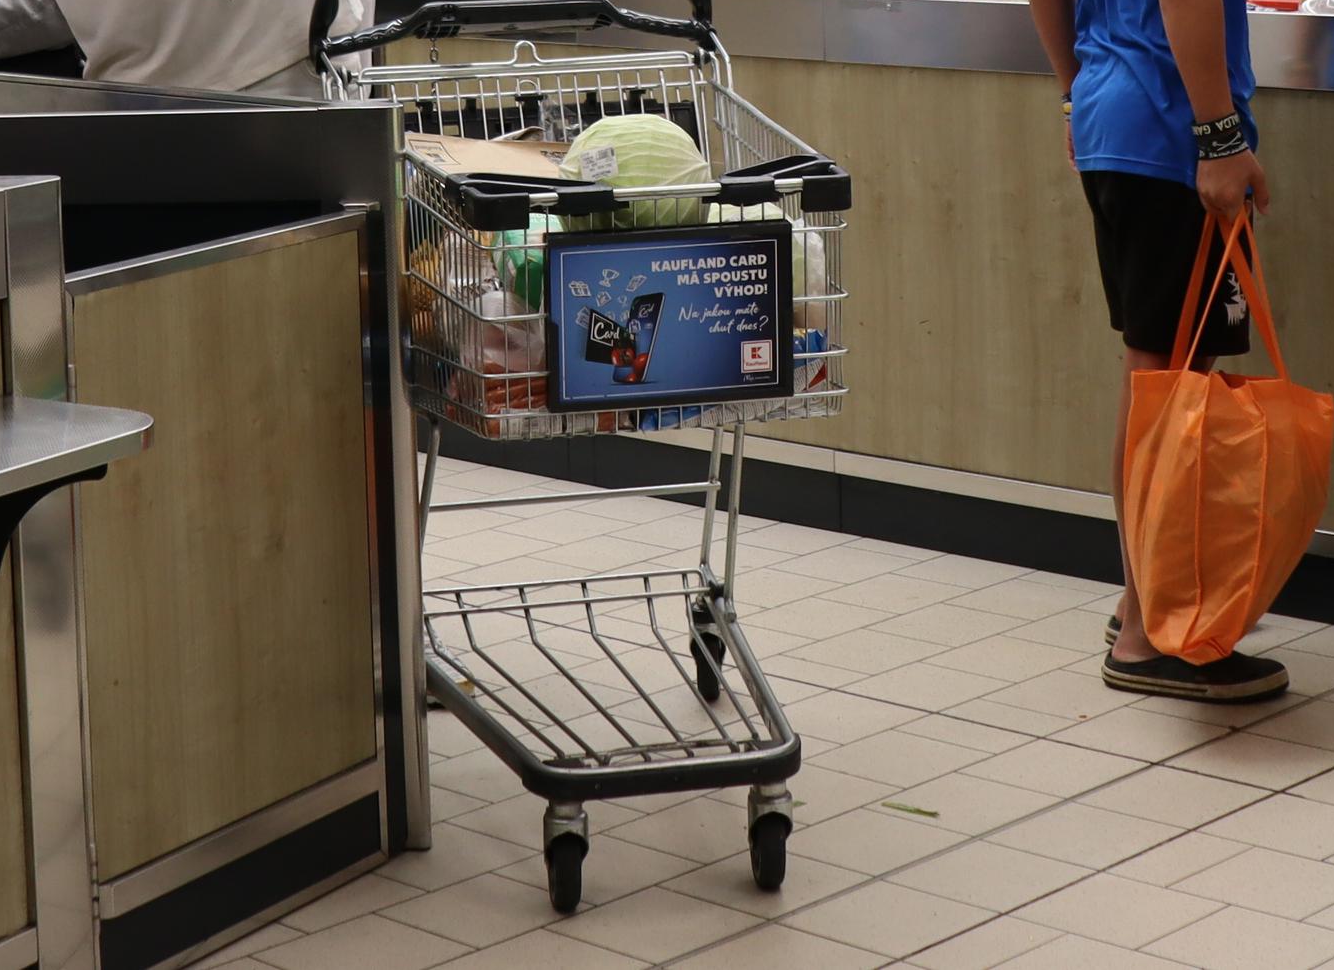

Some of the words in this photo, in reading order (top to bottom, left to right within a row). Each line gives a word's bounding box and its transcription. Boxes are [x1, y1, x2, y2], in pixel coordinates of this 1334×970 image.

[651, 257, 726, 272] KAUFLAND
[730, 254, 767, 266] CARD
[677, 272, 700, 286] MÁ
[703, 269, 768, 284] SPOUSTU
[714, 284, 768, 299] VÝHOD!
[678, 303, 699, 322] Na
[699, 304, 731, 323] jakou
[735, 302, 760, 315] máte
[594, 322, 620, 340] Card
[708, 319, 734, 335] chuť
[737, 315, 769, 333] dnes?
